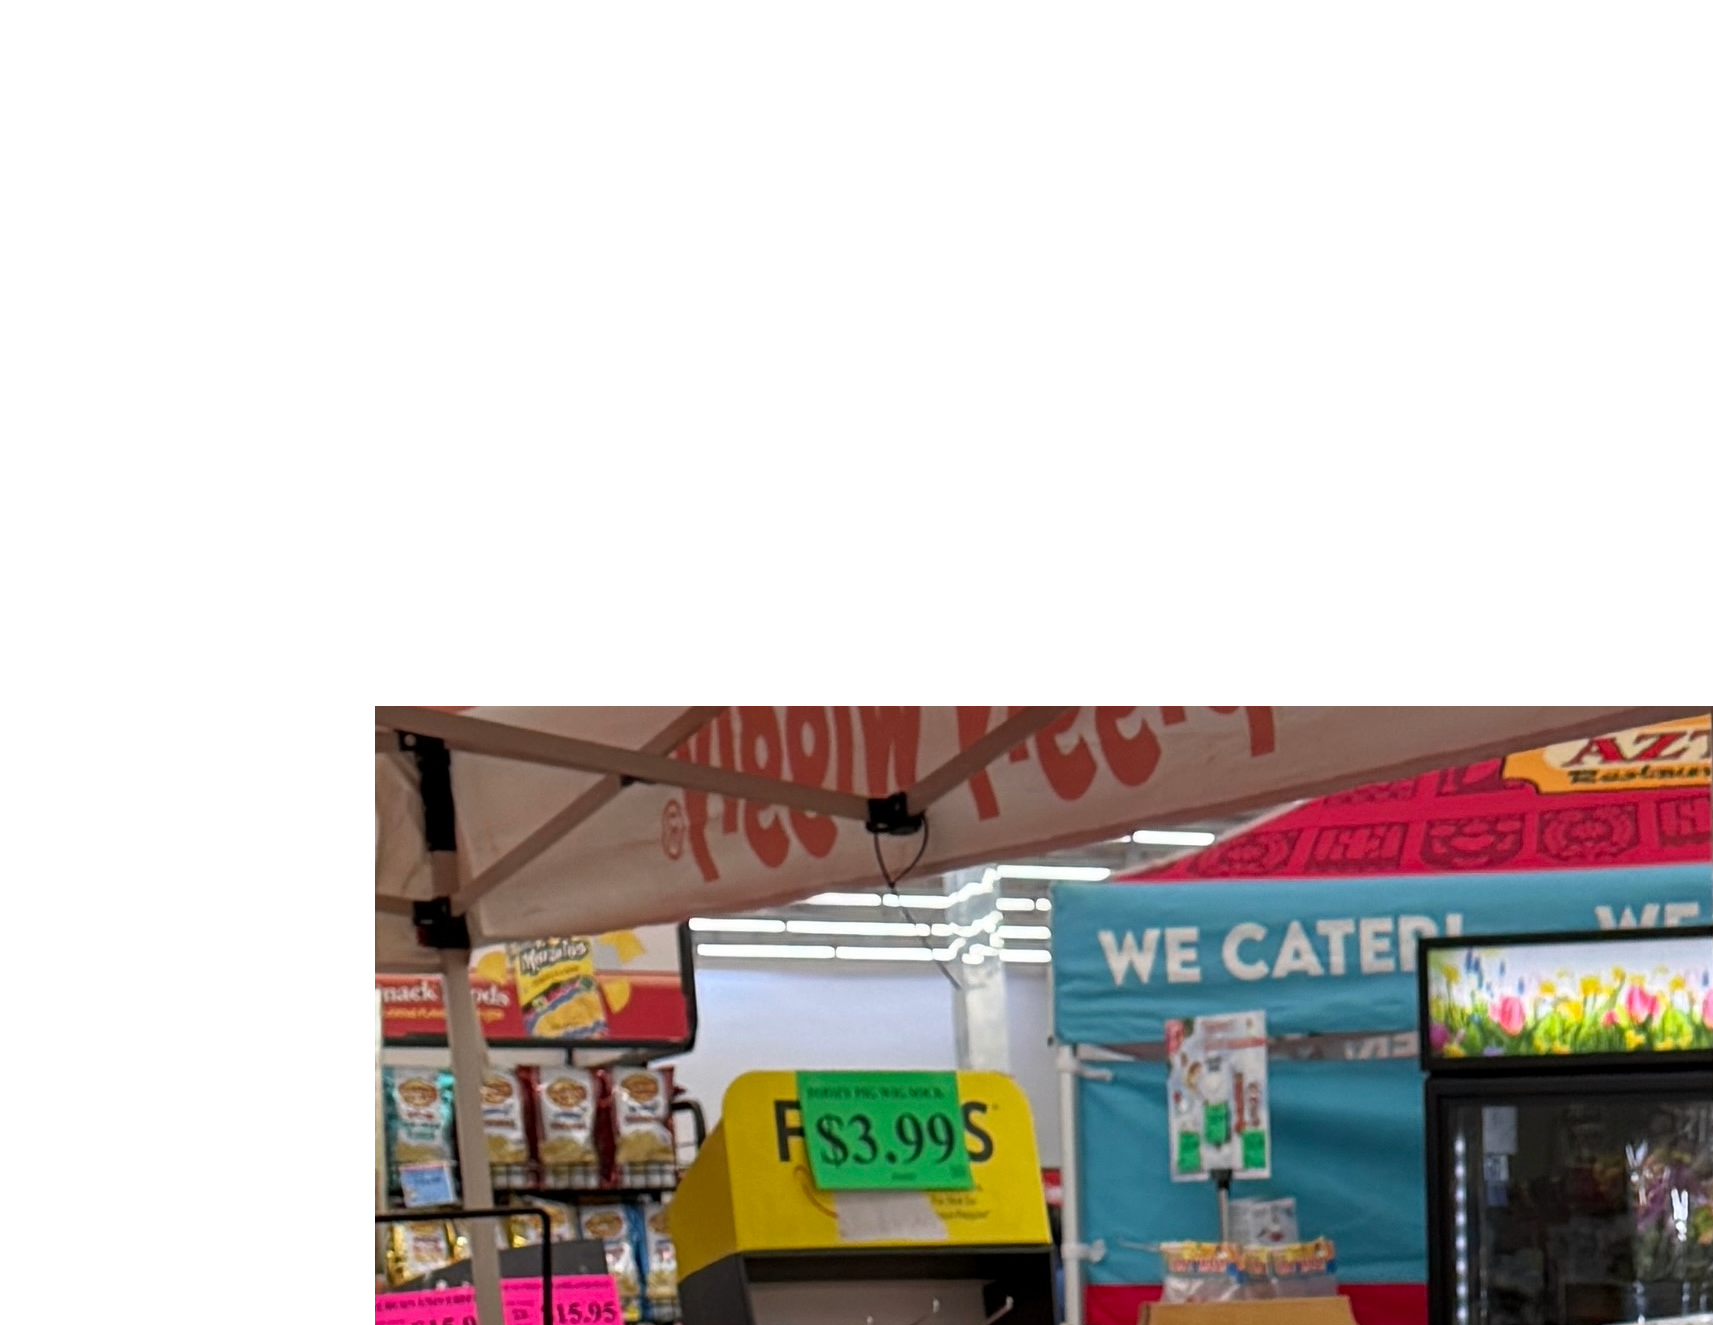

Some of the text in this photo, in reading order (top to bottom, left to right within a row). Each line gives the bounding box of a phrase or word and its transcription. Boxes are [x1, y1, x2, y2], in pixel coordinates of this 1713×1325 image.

[1097, 926, 1201, 987] WE
[380, 982, 438, 1002] nack
[816, 1111, 956, 1167] $3.99
[542, 1301, 617, 1325] 15.95
